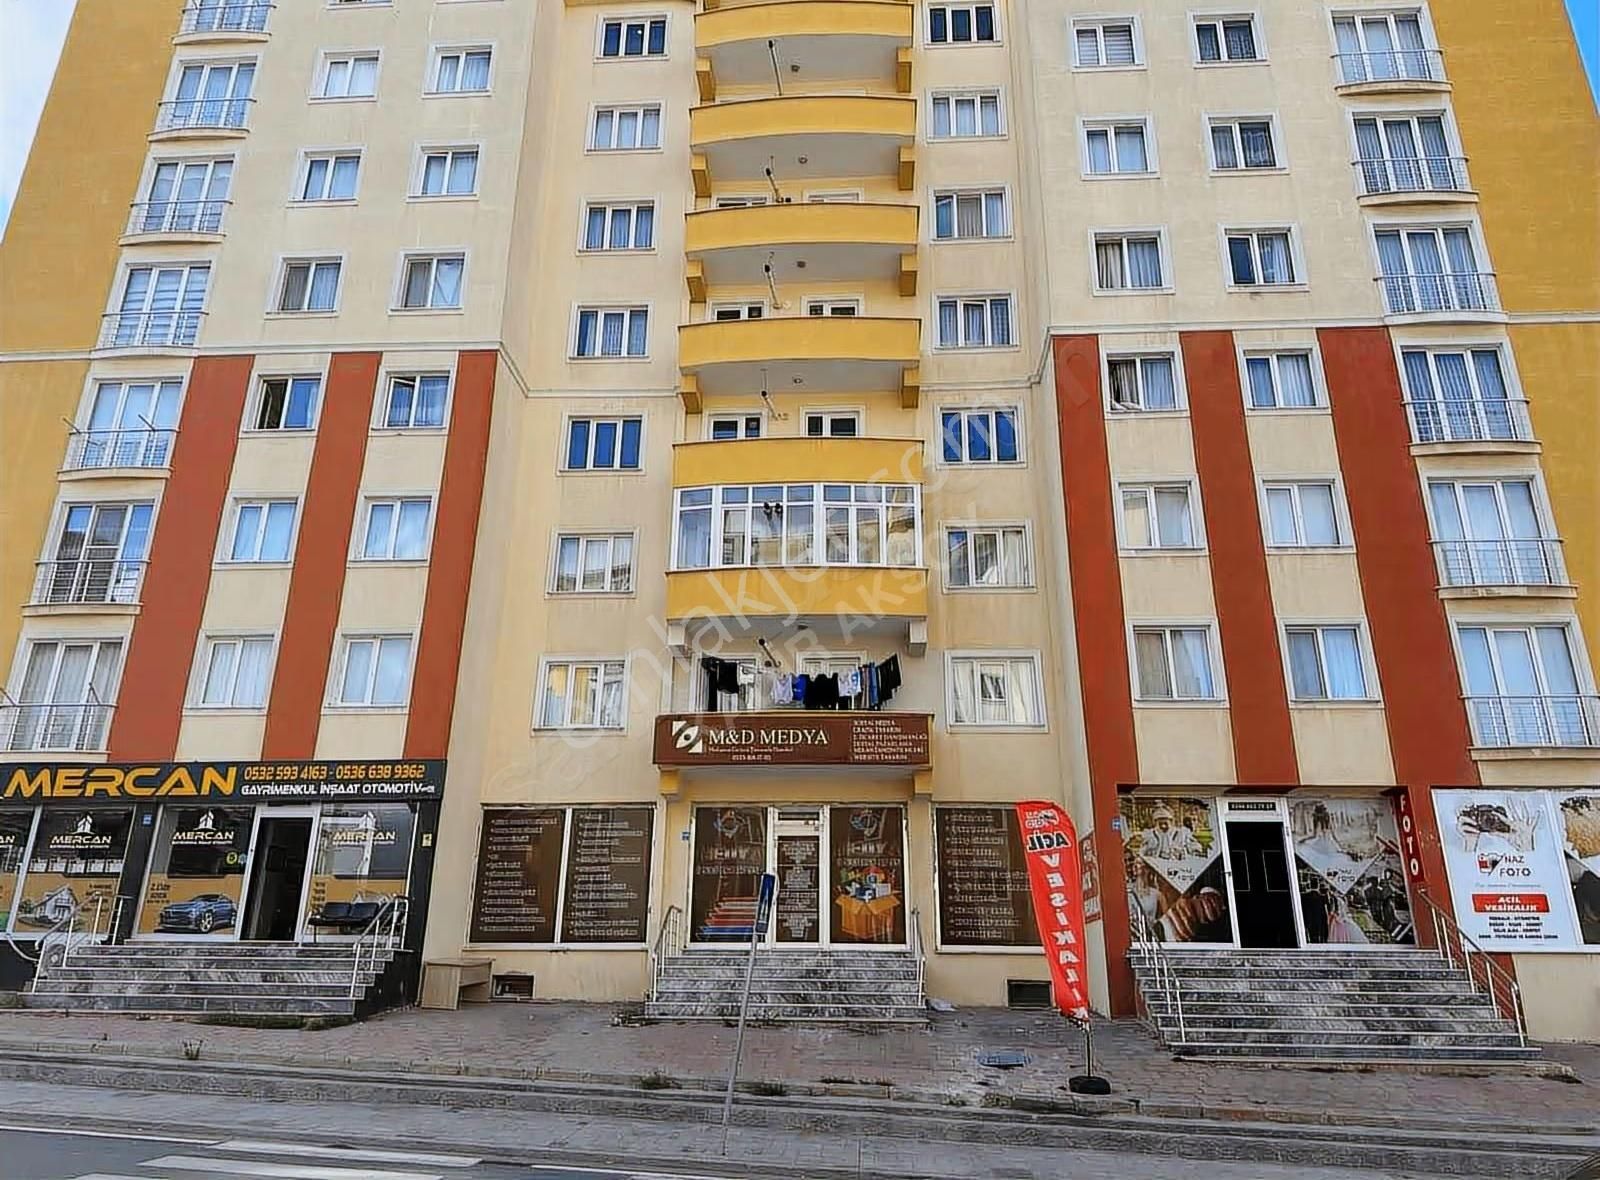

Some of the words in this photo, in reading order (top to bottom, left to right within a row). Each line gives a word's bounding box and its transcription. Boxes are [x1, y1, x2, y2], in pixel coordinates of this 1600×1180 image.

[708, 729, 755, 745] M&D
[760, 729, 828, 745] MEDYA
[244, 766, 273, 780] 0532
[275, 766, 299, 780] 593
[300, 765, 327, 780] 4163
[335, 765, 366, 780] 0536
[368, 765, 391, 779] 638
[393, 764, 426, 779] 9362
[3, 766, 237, 797] MERCAN
[241, 781, 316, 796] GAYRİMENKUL
[319, 780, 360, 797] İNŞAAT
[362, 780, 422, 795] OTOMOTİV
[51, 835, 111, 844] MERCAN
[172, 831, 234, 840] MERCAN
[333, 831, 396, 840] MERAN
[1400, 794, 1420, 876] FOTO
[1504, 855, 1525, 864] NAZ
[1499, 867, 1532, 877] FOTO
